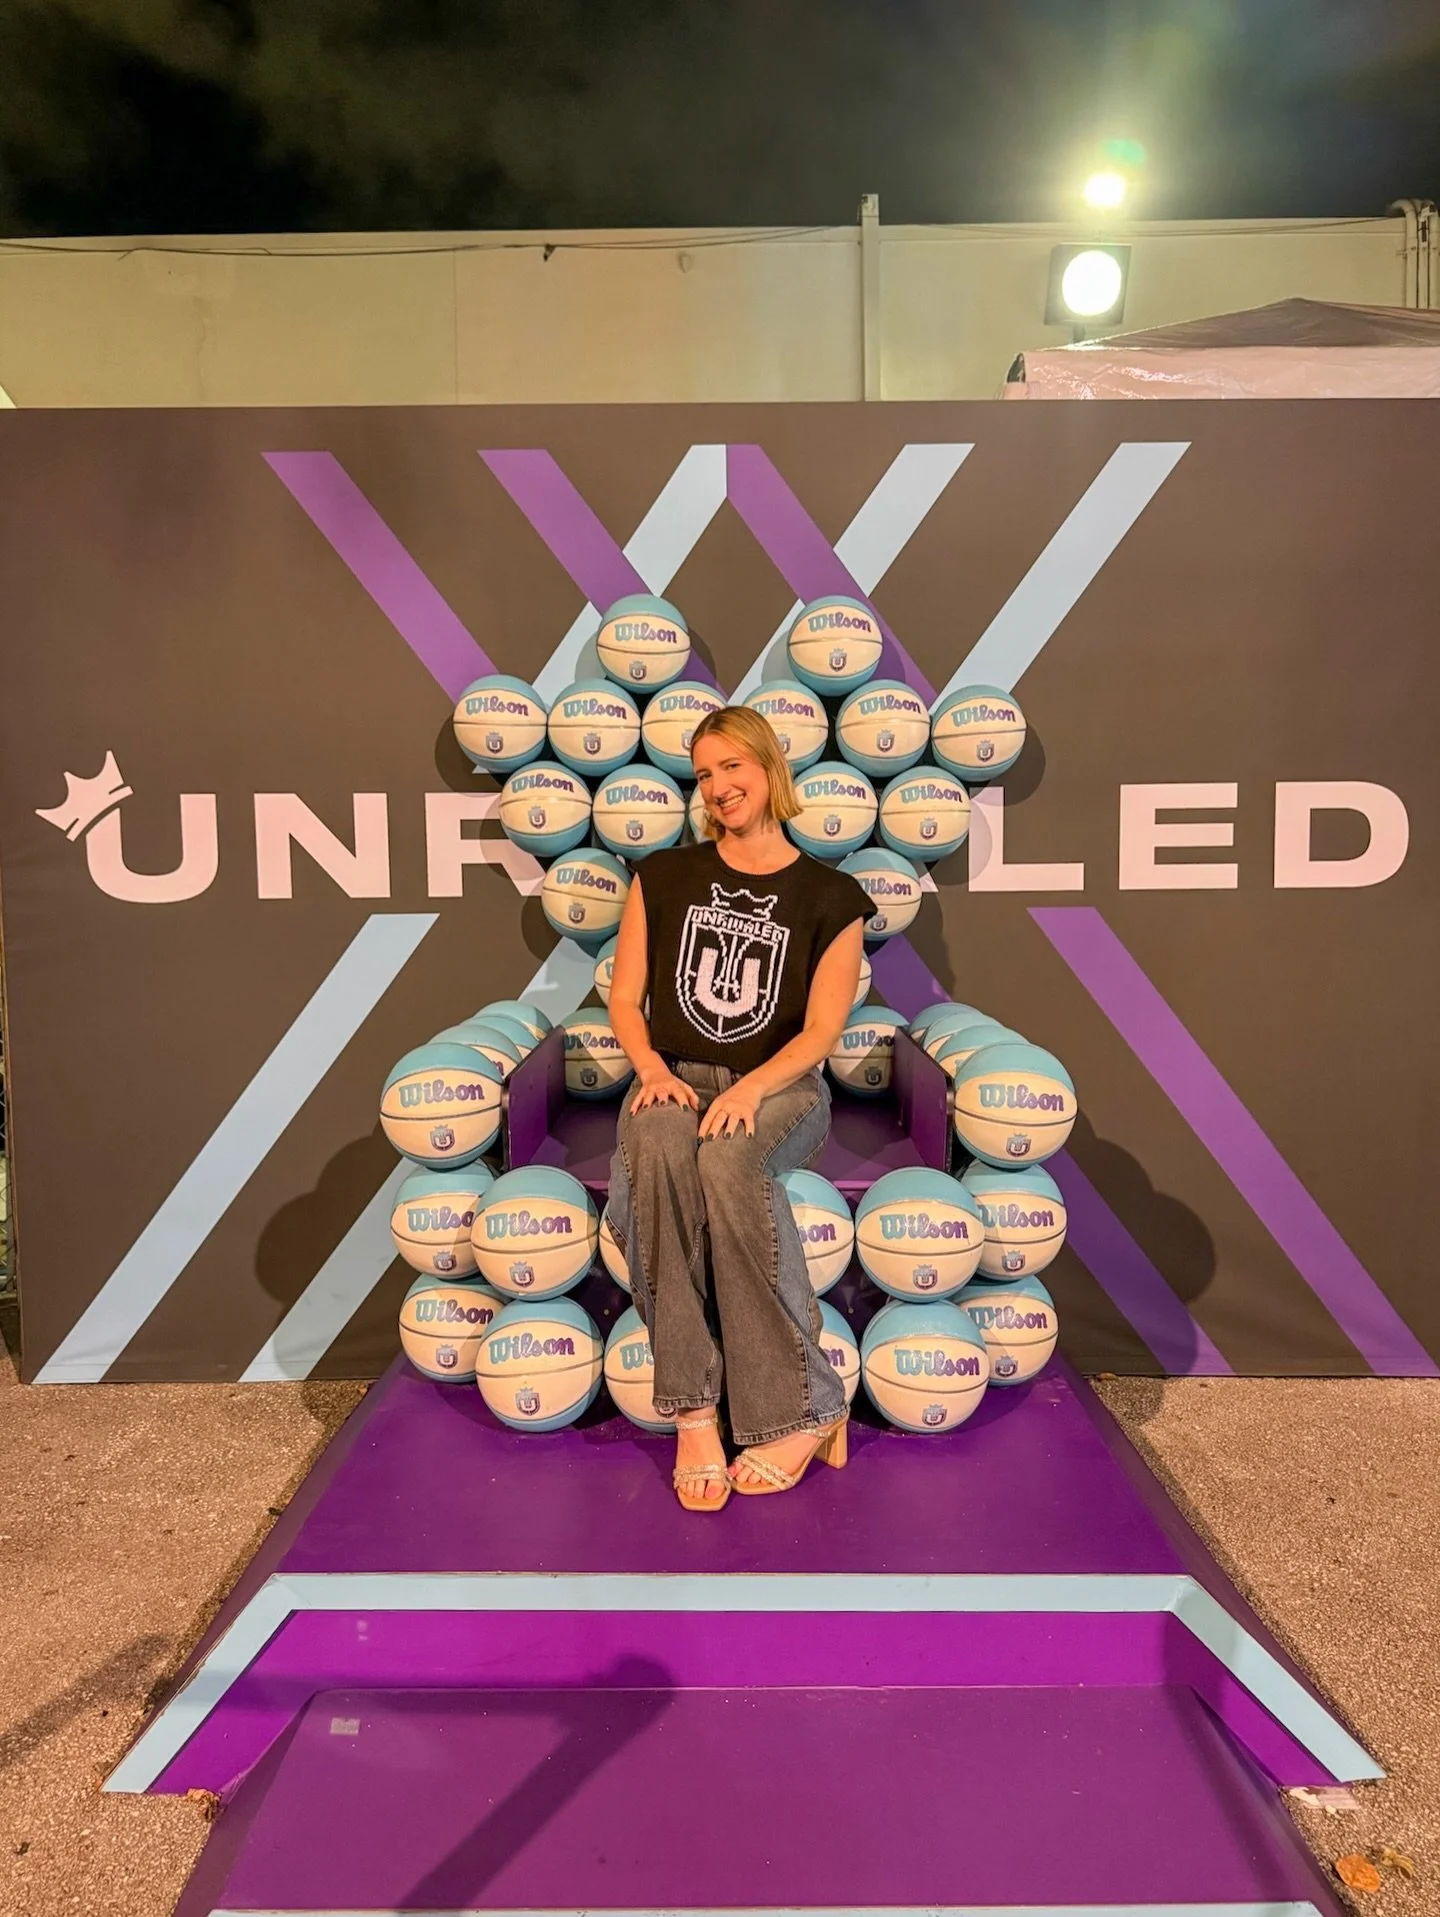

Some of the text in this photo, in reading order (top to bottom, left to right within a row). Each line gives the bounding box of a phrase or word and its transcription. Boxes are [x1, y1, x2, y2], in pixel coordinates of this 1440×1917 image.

[614, 622, 677, 644] Wilson
[808, 612, 871, 633] Wilson
[465, 695, 529, 717] Wilson
[563, 699, 627, 719] Wilson
[858, 695, 921, 714] Wilson
[951, 705, 1016, 727] Wilson
[511, 774, 574, 793] Wilson
[605, 785, 668, 805] Wilson
[803, 780, 866, 799] Wilson
[899, 784, 962, 803] Wilson
[86, 781, 1410, 904] UNRLED
[557, 868, 617, 894] Wilson
[694, 947, 761, 1018] U
[842, 1031, 894, 1050] Wilso
[399, 1080, 484, 1108] Wilson
[978, 1084, 1064, 1111] Wilson
[408, 1207, 474, 1232] Wilso
[486, 1210, 572, 1239] Wilson
[880, 1213, 968, 1240] Wilson
[978, 1204, 1054, 1226] Wilson
[416, 1299, 493, 1325] Wilson
[968, 1305, 1047, 1330] Wilson
[490, 1333, 575, 1364] Wilson
[895, 1348, 980, 1376] Wilson
